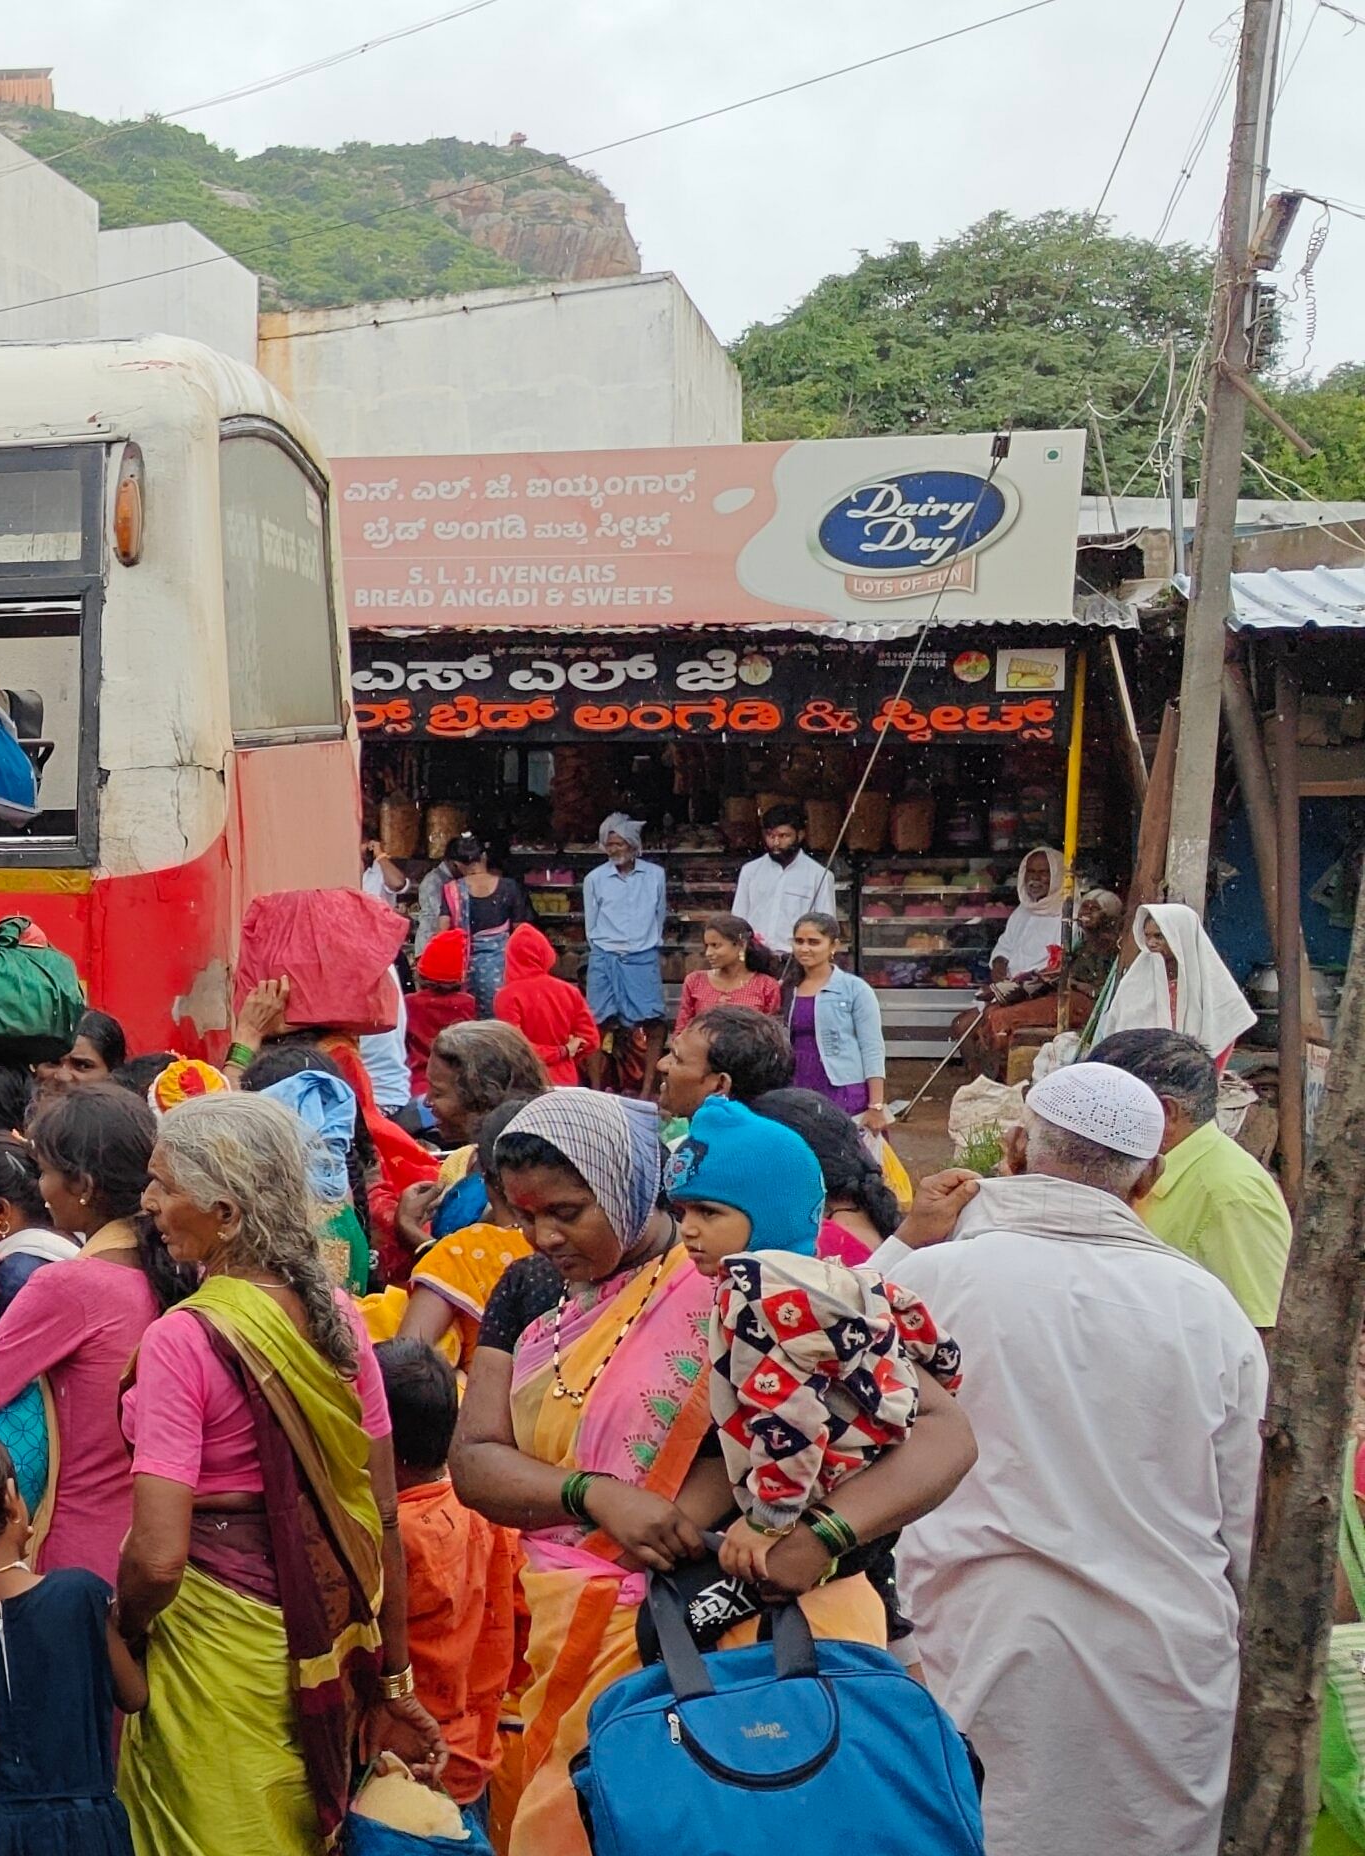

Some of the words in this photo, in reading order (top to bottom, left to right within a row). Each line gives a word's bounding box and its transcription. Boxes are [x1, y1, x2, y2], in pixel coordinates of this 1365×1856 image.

[846, 482, 975, 530] Dairy
[433, 514, 527, 540] ಅಂಗಡಿ
[533, 520, 588, 545] ಮತ್ತು
[859, 517, 956, 565] Day
[408, 567, 430, 584] S.
[437, 567, 457, 584] L.
[463, 566, 482, 584] J.
[490, 564, 616, 584] IYENGARS
[853, 578, 894, 594] LOTS
[900, 577, 922, 591] OF
[928, 566, 962, 586] FUN
[354, 588, 434, 607] BREAD
[441, 587, 537, 607] ANGADI
[545, 587, 564, 606] &
[571, 585, 674, 606] SWEETS
[351, 655, 493, 691] ಎಸ್
[508, 653, 657, 691] ಎಲ್
[574, 697, 781, 730] ಅಂಗಡಿ
[798, 700, 859, 732] &
